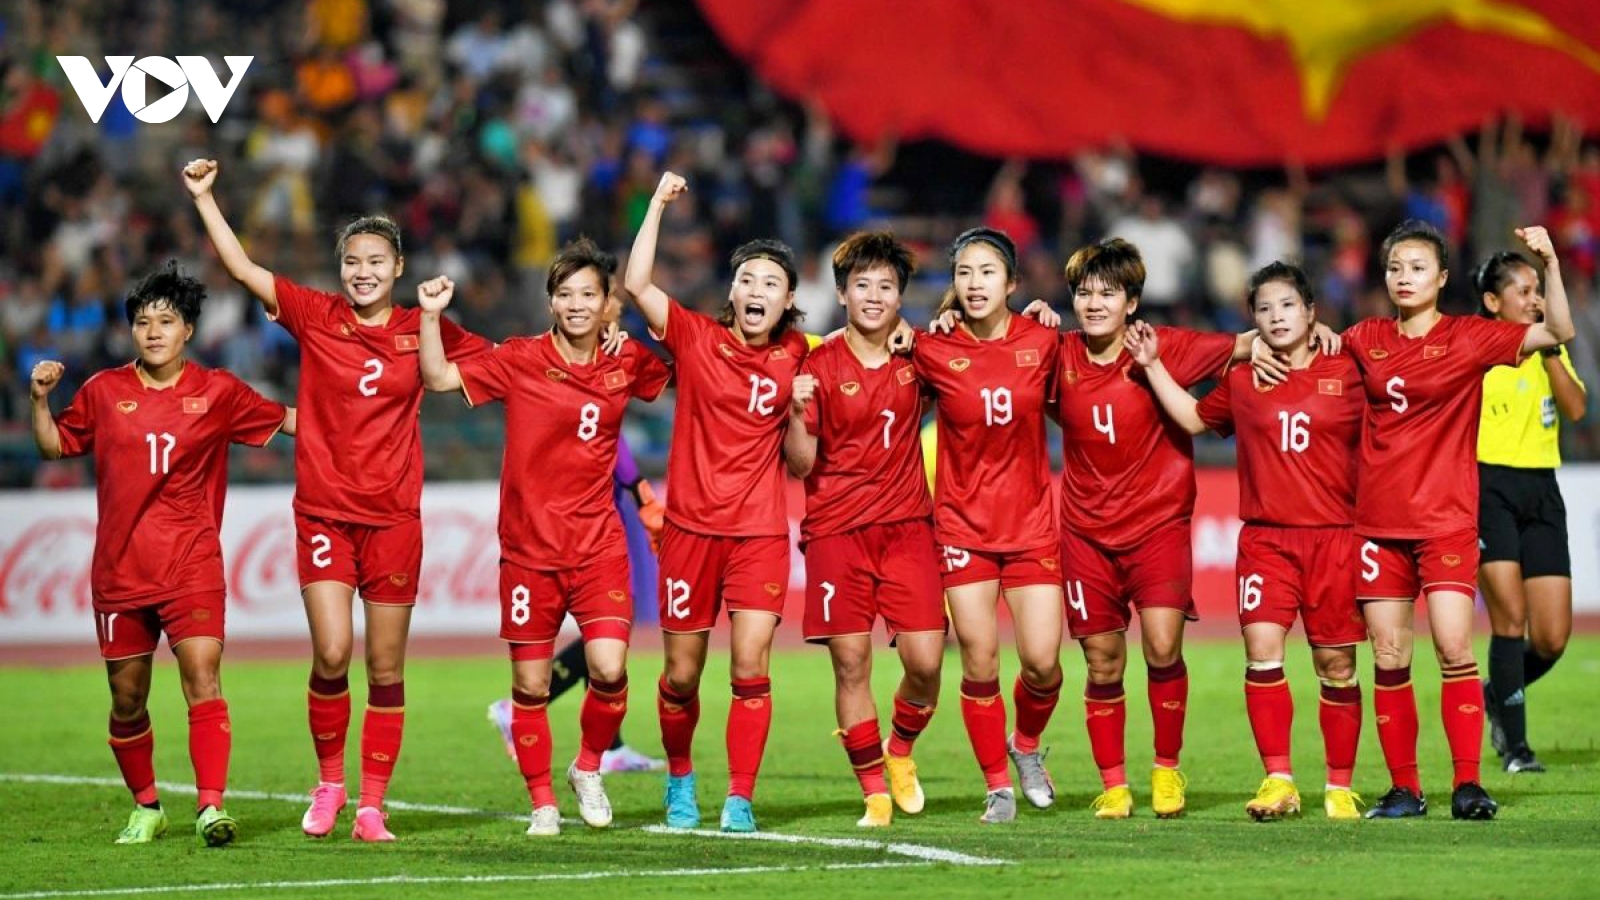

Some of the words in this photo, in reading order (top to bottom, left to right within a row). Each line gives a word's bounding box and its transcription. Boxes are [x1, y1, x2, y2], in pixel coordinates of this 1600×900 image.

[359, 358, 384, 397] 2
[748, 374, 777, 416] 12
[577, 403, 600, 441] 8
[980, 386, 1013, 426] 19
[1092, 403, 1116, 444] 4
[880, 409, 896, 449] 7
[1278, 411, 1311, 453] 16
[146, 432, 176, 475] 17
[311, 533, 332, 568] 2
[511, 585, 530, 626] 8
[666, 577, 691, 620] 12
[820, 581, 836, 622] 7
[1067, 580, 1088, 621] 4
[1239, 573, 1264, 614] 16
